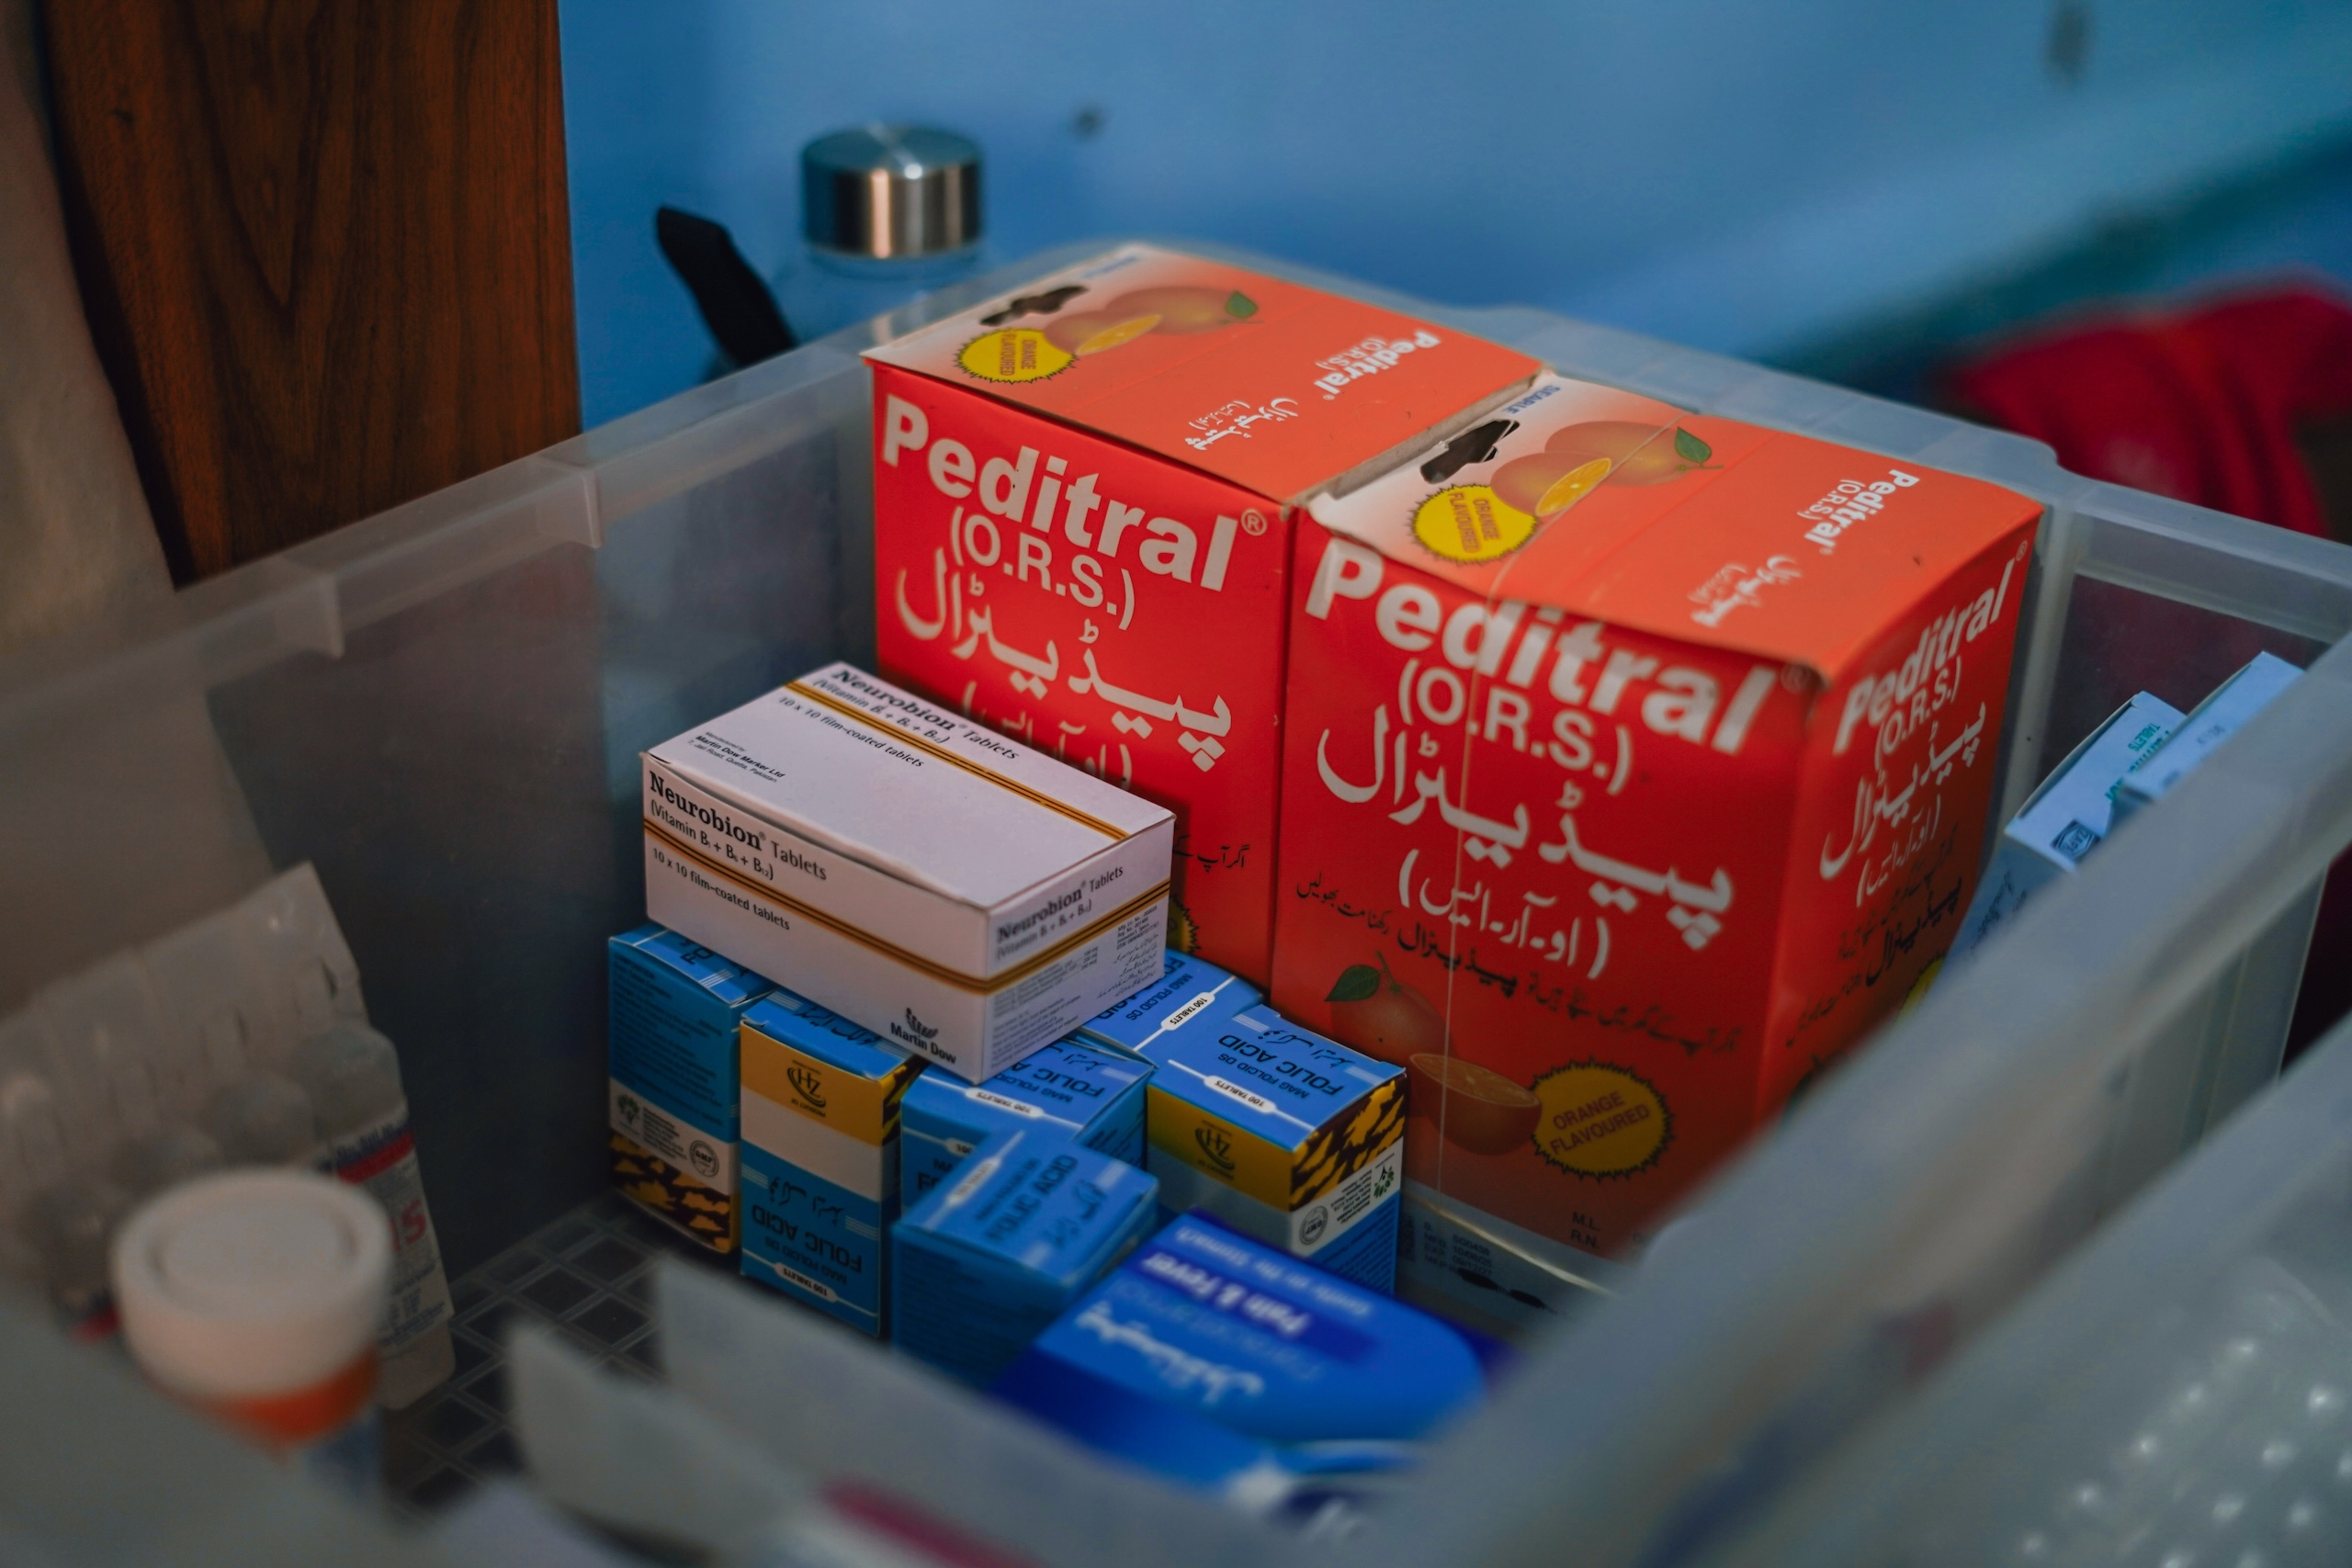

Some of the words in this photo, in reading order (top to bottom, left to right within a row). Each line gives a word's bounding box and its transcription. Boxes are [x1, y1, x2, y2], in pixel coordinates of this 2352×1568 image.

[1000, 330, 1017, 377] FLAVOURED
[1020, 338, 1036, 370] ORANGE
[1501, 385, 1560, 414] SEARLE
[1797, 479, 1865, 520] (O.R.S.)
[1449, 492, 1480, 553] FLAVOURED
[1473, 498, 1500, 540] ORANGE
[949, 505, 1135, 631] (O.R.S.)
[813, 679, 869, 708] (Vitamin
[1399, 659, 1631, 795] (O.R.S.)
[1874, 656, 1962, 772] (O.R.S.)
[779, 696, 793, 706] 10
[806, 709, 821, 719] 10
[820, 716, 885, 750] film-coated
[885, 745, 924, 768] tablets
[962, 730, 1019, 760] Tablets
[2127, 723, 2161, 753] TABLETS
[695, 735, 721, 750] Martin
[721, 747, 741, 758] Dow
[740, 755, 769, 771] Marker
[768, 768, 786, 778] Ltd
[651, 799, 696, 840] (Vitamin
[771, 840, 827, 881] Tablets
[653, 848, 664, 863] 10
[676, 863, 687, 877] 10
[690, 872, 750, 910] film-coated
[753, 904, 790, 931] tablets
[1090, 866, 1124, 892] Tablets
[996, 931, 1038, 961] (Vitamin
[1169, 974, 1193, 989] MAG
[1140, 988, 1172, 1011] FOLCID
[1193, 998, 1207, 1009] 100
[1125, 1010, 1144, 1021] DS
[1170, 1006, 1195, 1025] TABLETS
[890, 1021, 927, 1052] Martin
[930, 1042, 956, 1064] Dow
[1218, 1034, 1277, 1063] ACID
[1218, 1053, 1237, 1066] DS
[1237, 1062, 1279, 1085] FOLCID
[1034, 1067, 1105, 1098] FOLIC
[1214, 1080, 1249, 1099] TABLETS
[1275, 1061, 1344, 1096] FOLIC
[1279, 1082, 1310, 1100] MAG
[1041, 1089, 1073, 1102] MAG
[1248, 1095, 1265, 1108] 100
[1553, 1090, 1625, 1132] ORANGE
[1549, 1103, 1651, 1156] FLAVOURED
[984, 1194, 1042, 1241] FOLIC
[1031, 1154, 1079, 1194] ACID
[752, 1204, 798, 1241] ACID
[1572, 1212, 1600, 1232] M.L.
[764, 1236, 780, 1251] DS
[805, 1231, 862, 1273] FOLIC
[1570, 1227, 1600, 1249] R.N.
[783, 1245, 819, 1272] FOLCID
[784, 1269, 812, 1288] TABLETS
[820, 1263, 848, 1285] MAG
[1142, 1252, 1221, 1298] Fever
[813, 1283, 828, 1296] 100
[1244, 1294, 1311, 1335] Pain
